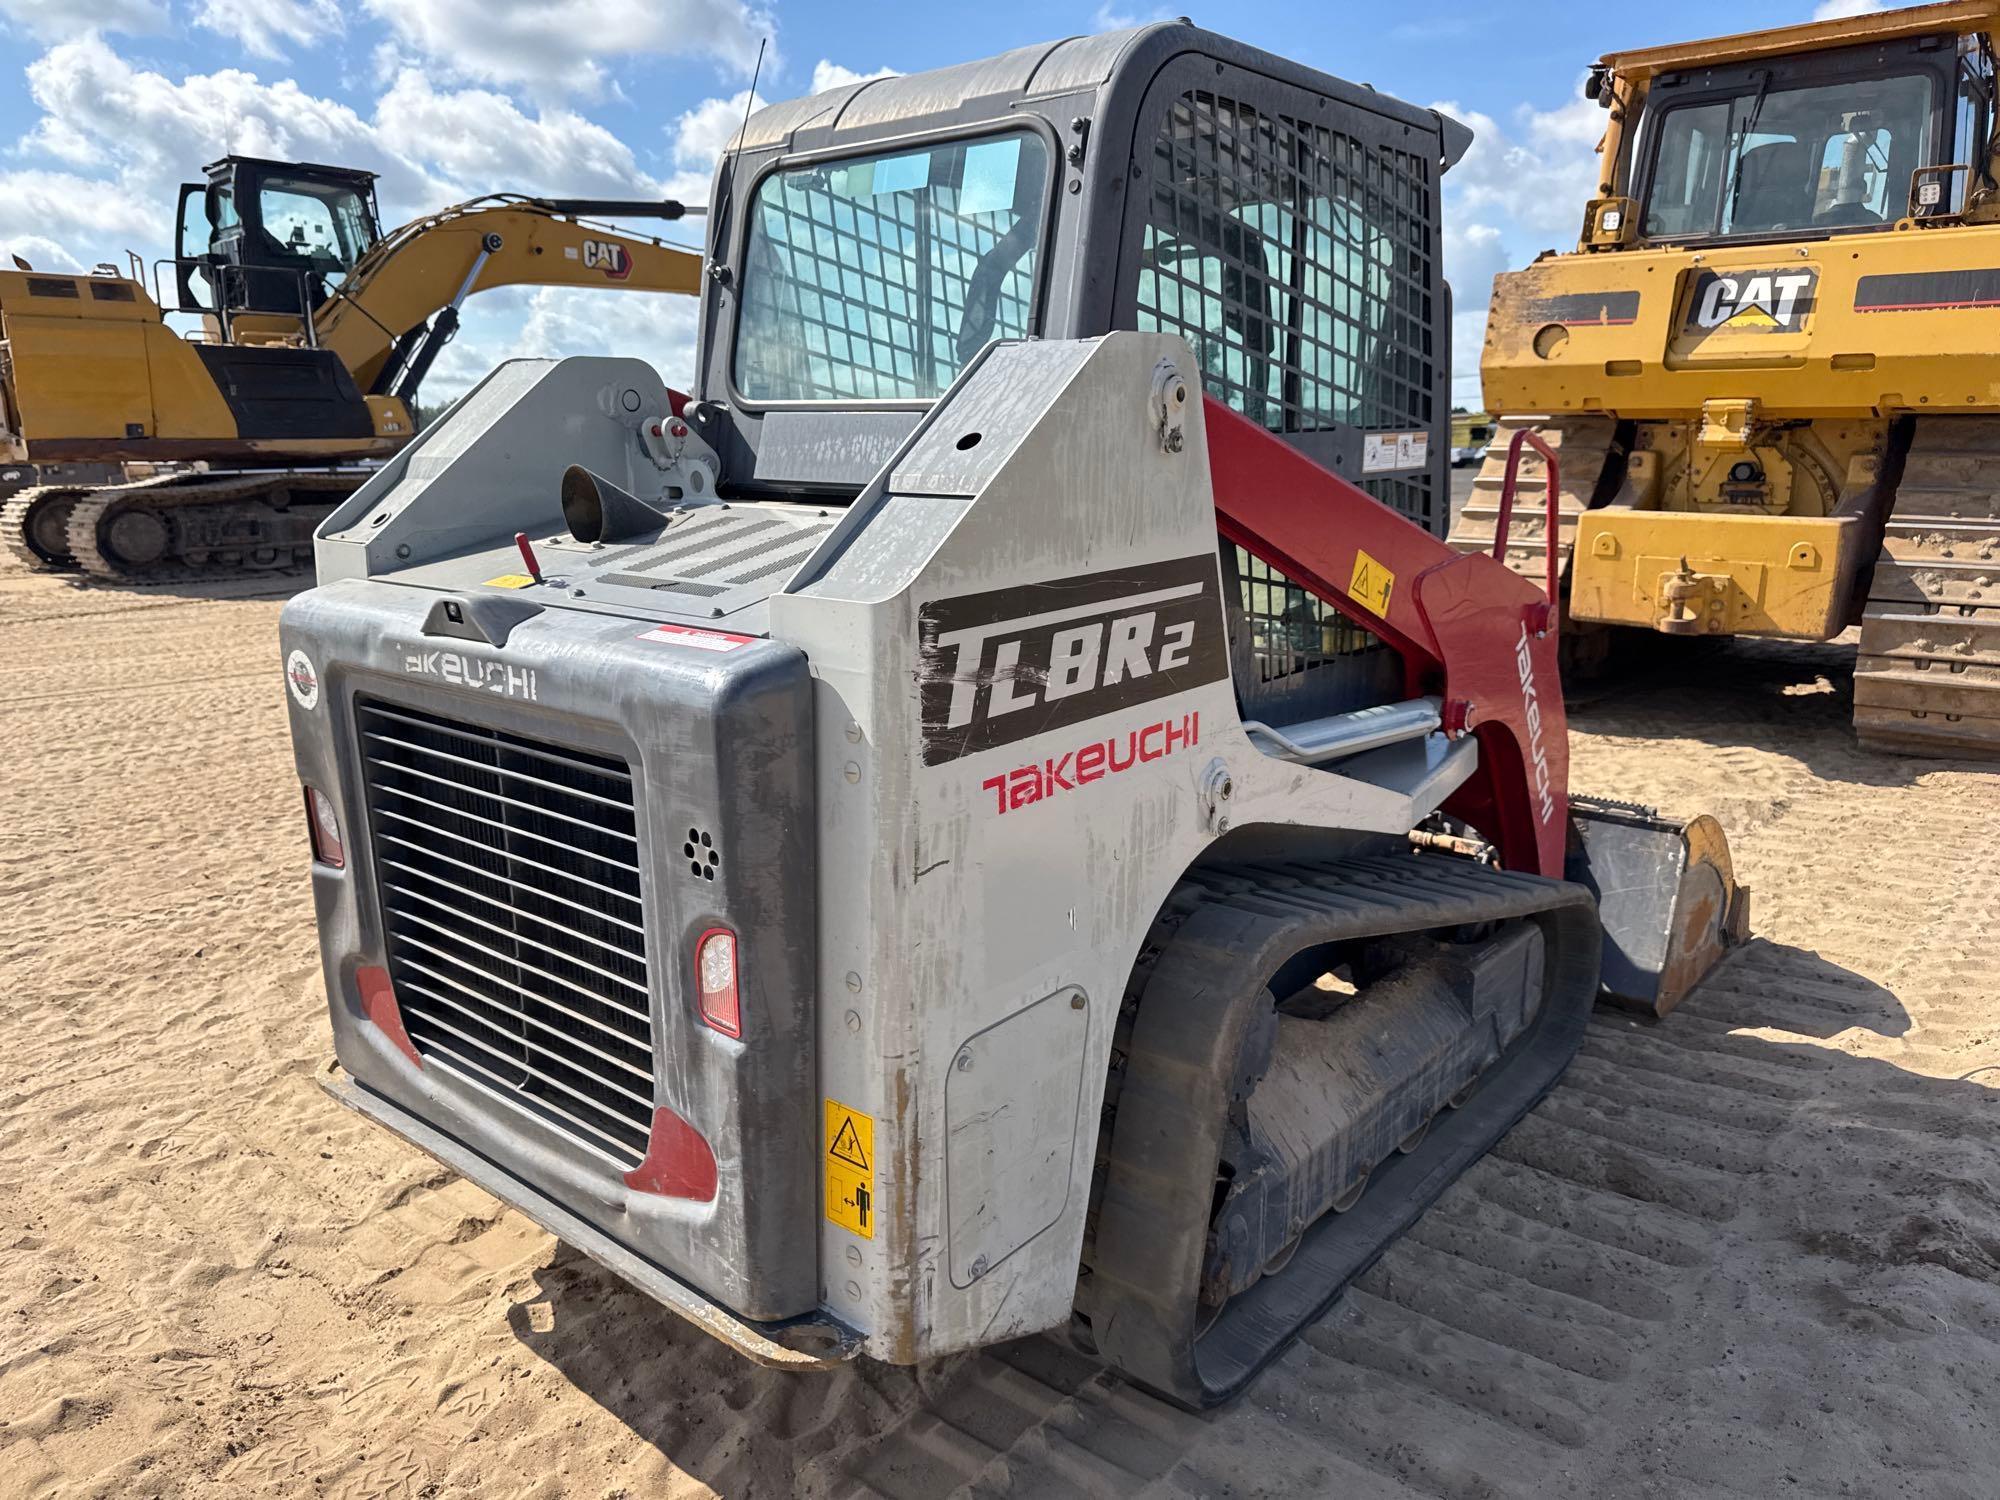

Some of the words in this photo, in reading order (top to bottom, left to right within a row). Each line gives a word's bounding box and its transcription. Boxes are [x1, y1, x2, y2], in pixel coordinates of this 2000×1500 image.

[584, 240, 620, 272] CAT
[1698, 275, 1811, 328] CAT
[937, 582, 1204, 729] TL8R2
